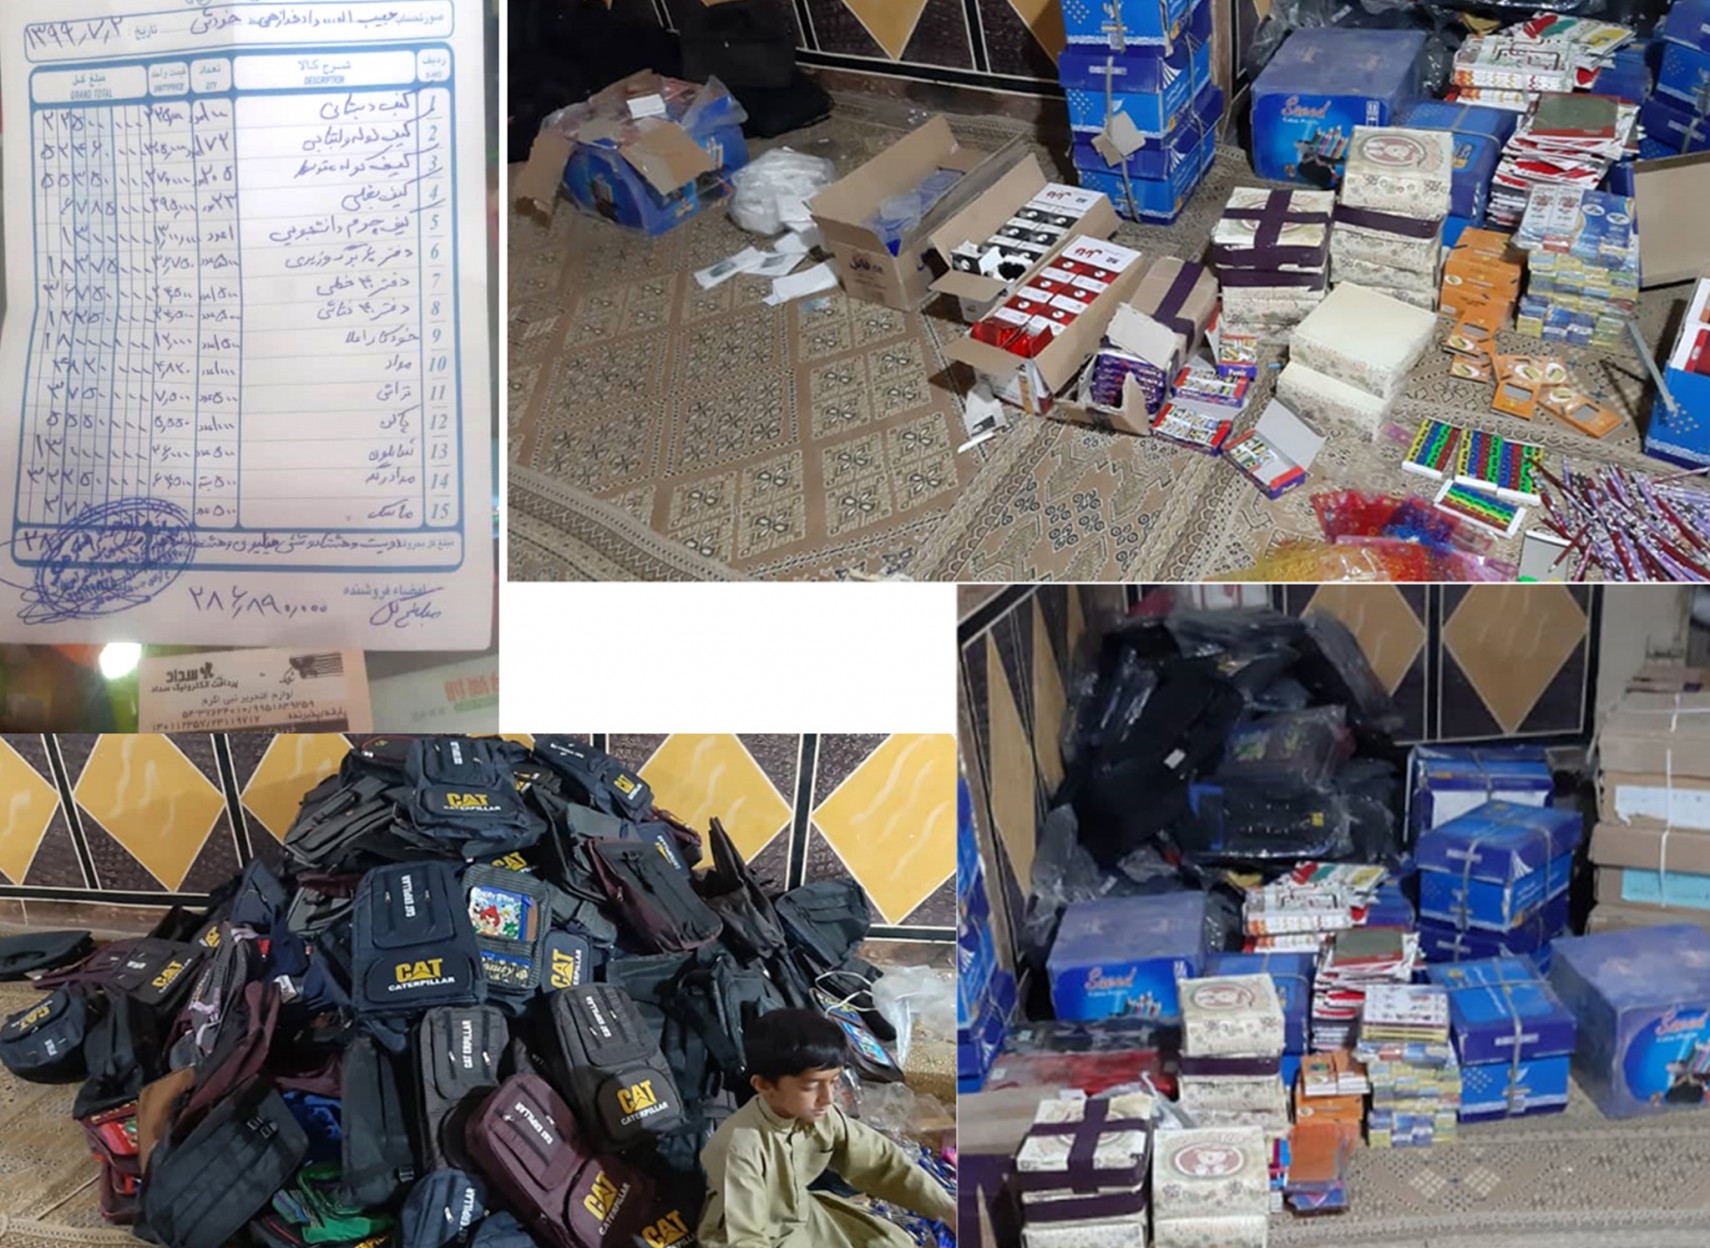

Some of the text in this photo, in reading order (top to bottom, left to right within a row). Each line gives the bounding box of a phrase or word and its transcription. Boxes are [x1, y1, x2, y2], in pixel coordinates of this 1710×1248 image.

[135, 24, 158, 41] تاریخ
[298, 59, 351, 74] شرح کالا
[421, 54, 446, 66] ردیف
[199, 65, 221, 75] تعداد
[72, 74, 107, 87] مبلغ کل
[205, 81, 217, 90] QTY
[304, 75, 345, 85] DESCRIPTION
[70, 88, 113, 100] GRAND TOTAL
[429, 95, 436, 112] 1
[427, 125, 437, 142] 2
[428, 154, 437, 171] 3
[429, 184, 439, 201] 4
[429, 214, 440, 231] 5
[376, 246, 414, 267] دفتر
[430, 243, 440, 259] 6
[316, 274, 355, 297] خطی
[368, 271, 411, 297] دفتر
[432, 273, 441, 291] 7
[369, 297, 411, 321] دفتر
[431, 300, 441, 316] 8
[432, 328, 442, 343] 9
[384, 353, 413, 371] مداد
[428, 355, 447, 372] 10
[376, 380, 412, 401] تراش
[430, 385, 446, 401] 11
[430, 414, 448, 430] 12
[430, 443, 448, 460] 13
[431, 473, 449, 490] 14
[431, 504, 449, 520] 15
[343, 583, 391, 599] فروشنده
[165, 668, 199, 684] سداد
[446, 792, 489, 807] CAT
[152, 961, 183, 989] CAT
[394, 957, 444, 982] CAT
[550, 948, 575, 989] CAT
[387, 975, 456, 993] CATERPILLAR
[616, 1079, 658, 1116] CAT
[620, 1101, 670, 1127] CATERPILLAR
[582, 1169, 619, 1221] CAT
[598, 1182, 632, 1237] CATERPILLAR
[641, 1209, 690, 1248] CAT
